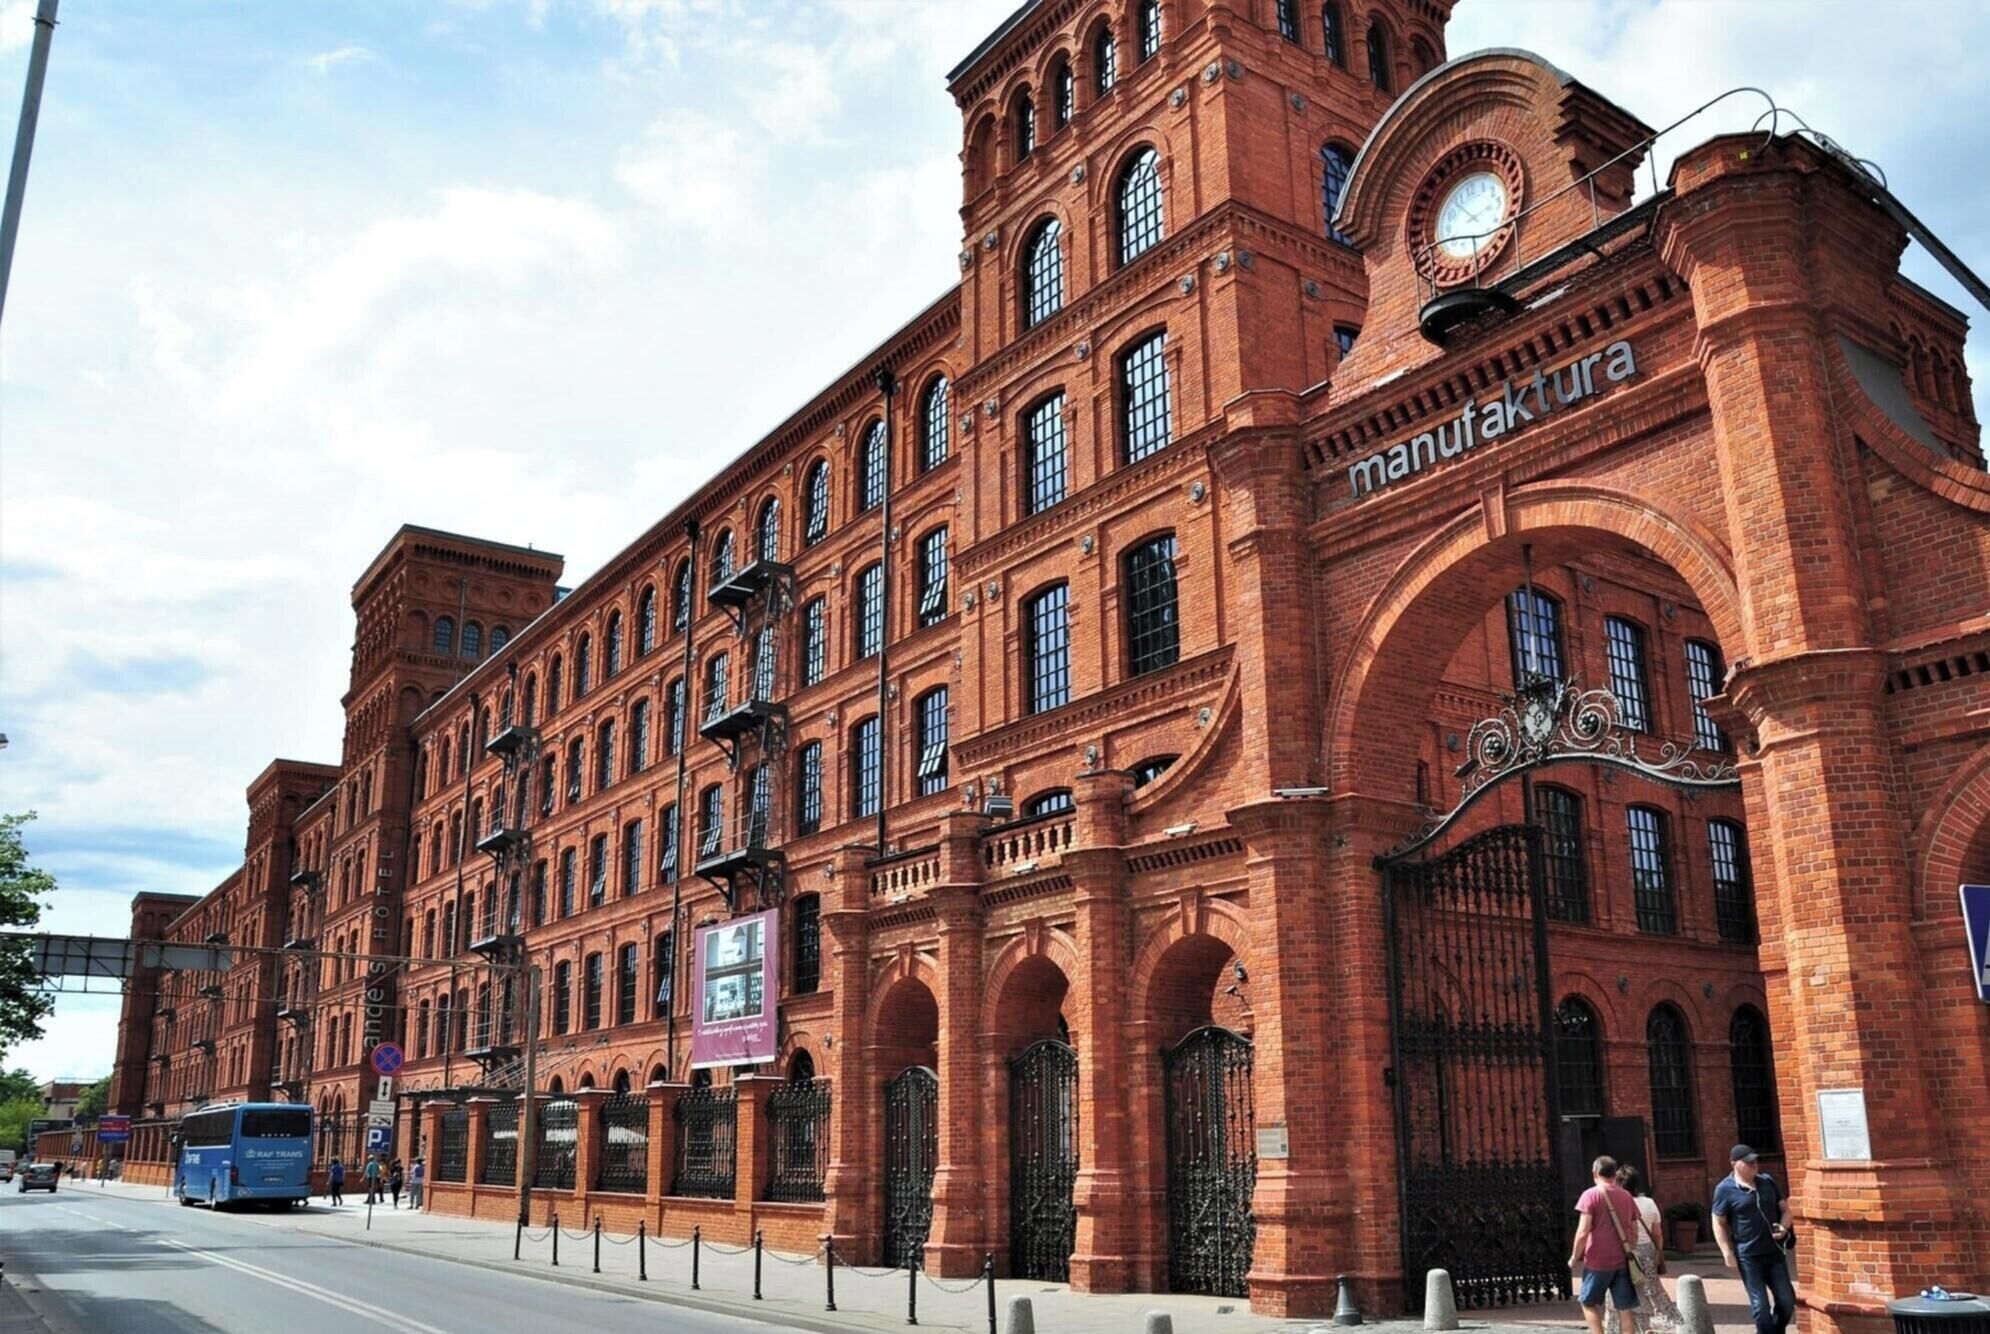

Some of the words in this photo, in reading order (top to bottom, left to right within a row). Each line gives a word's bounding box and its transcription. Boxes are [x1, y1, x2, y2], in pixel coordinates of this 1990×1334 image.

[1349, 340, 1637, 497] manufaktura
[373, 850, 394, 939] HOTEL
[367, 1128, 383, 1148] P
